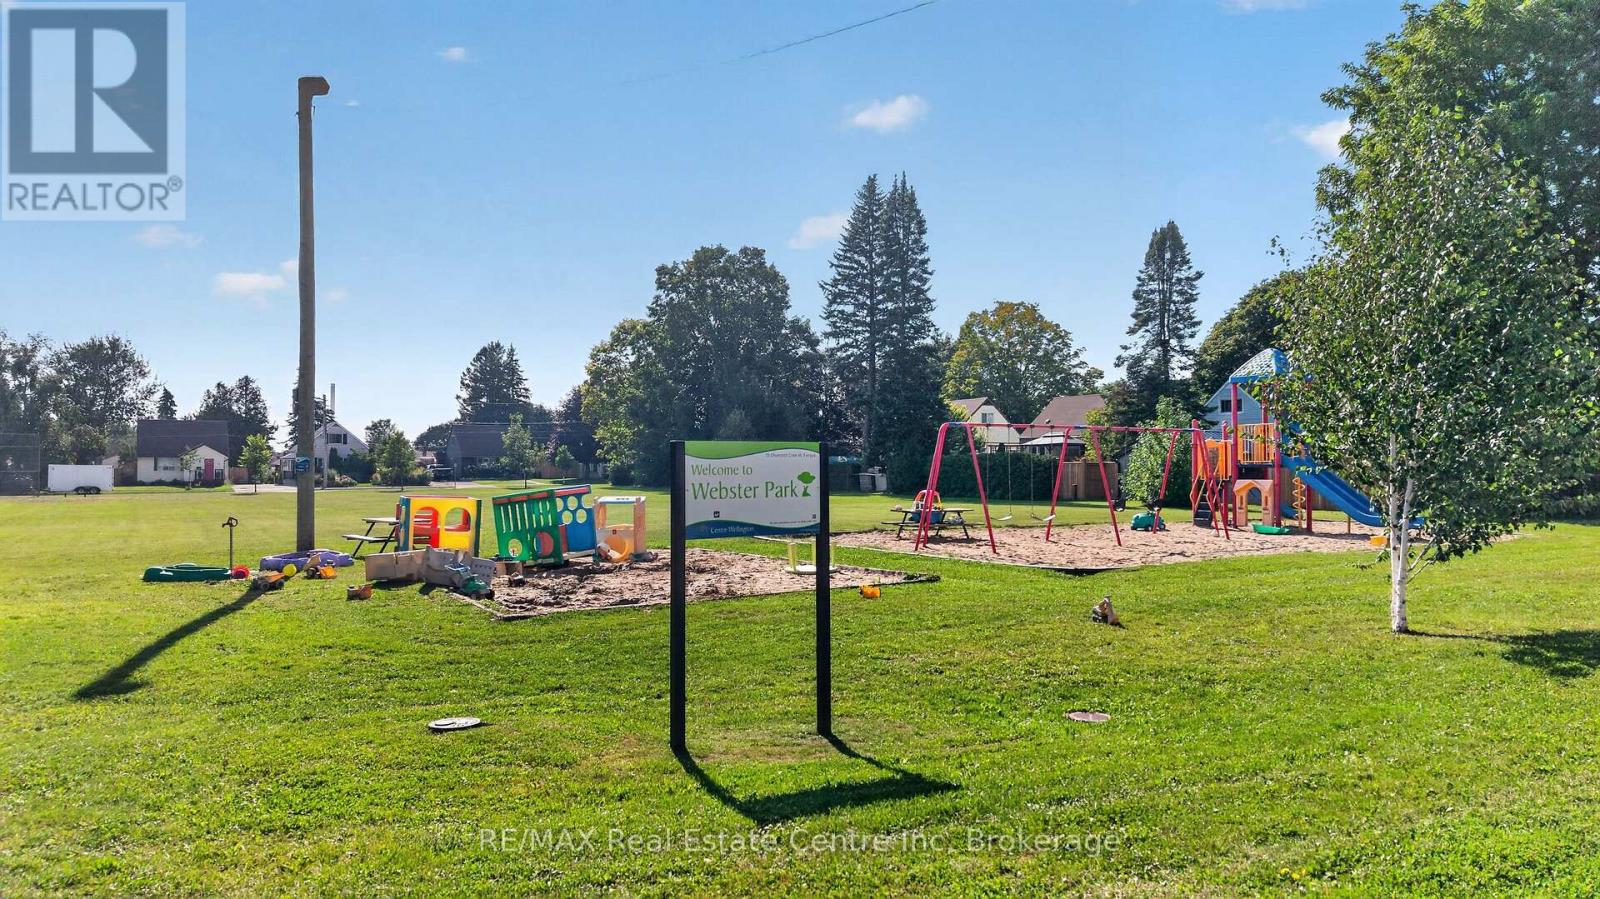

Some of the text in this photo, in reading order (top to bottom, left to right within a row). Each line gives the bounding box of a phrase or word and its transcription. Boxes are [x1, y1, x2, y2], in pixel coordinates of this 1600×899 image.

[691, 464, 753, 476] Welcome to
[691, 480, 798, 500] Webster Park
